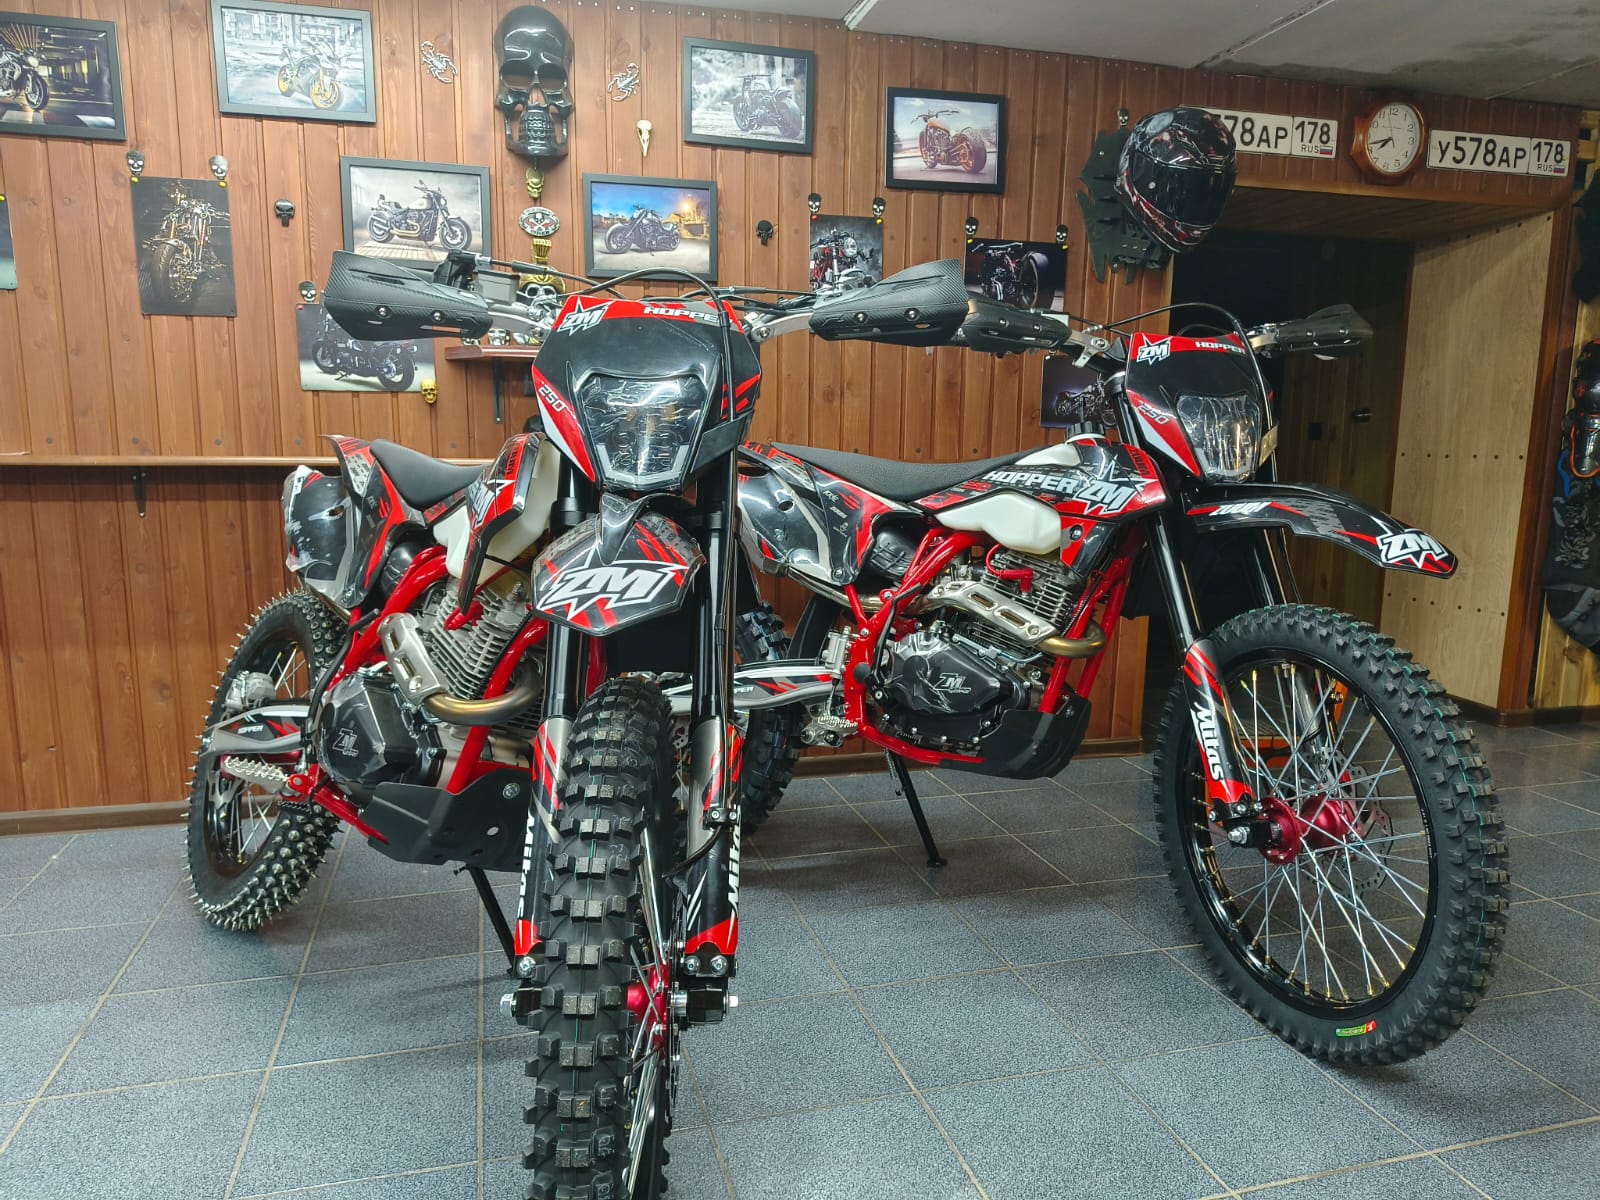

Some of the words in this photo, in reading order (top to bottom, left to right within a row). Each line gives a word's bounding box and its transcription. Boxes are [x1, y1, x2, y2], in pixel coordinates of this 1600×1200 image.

[1295, 120, 1331, 145] 178
[1407, 123, 1414, 133] 2
[1301, 144, 1319, 154] RUS
[1408, 136, 1415, 145] 3
[1532, 140, 1564, 164] 178
[1402, 150, 1409, 159] 4
[1536, 163, 1553, 173] RUS
[643, 306, 733, 326] HOPPE
[1138, 342, 1169, 358] ZM
[1195, 341, 1247, 355] HOPPER
[538, 384, 567, 412] 250
[1138, 402, 1169, 425] 250
[982, 470, 1080, 494] HOPPER
[1076, 479, 1138, 511] ZM
[1382, 532, 1445, 560] ZM
[545, 565, 671, 606] ZM
[1193, 701, 1224, 781] Mitas
